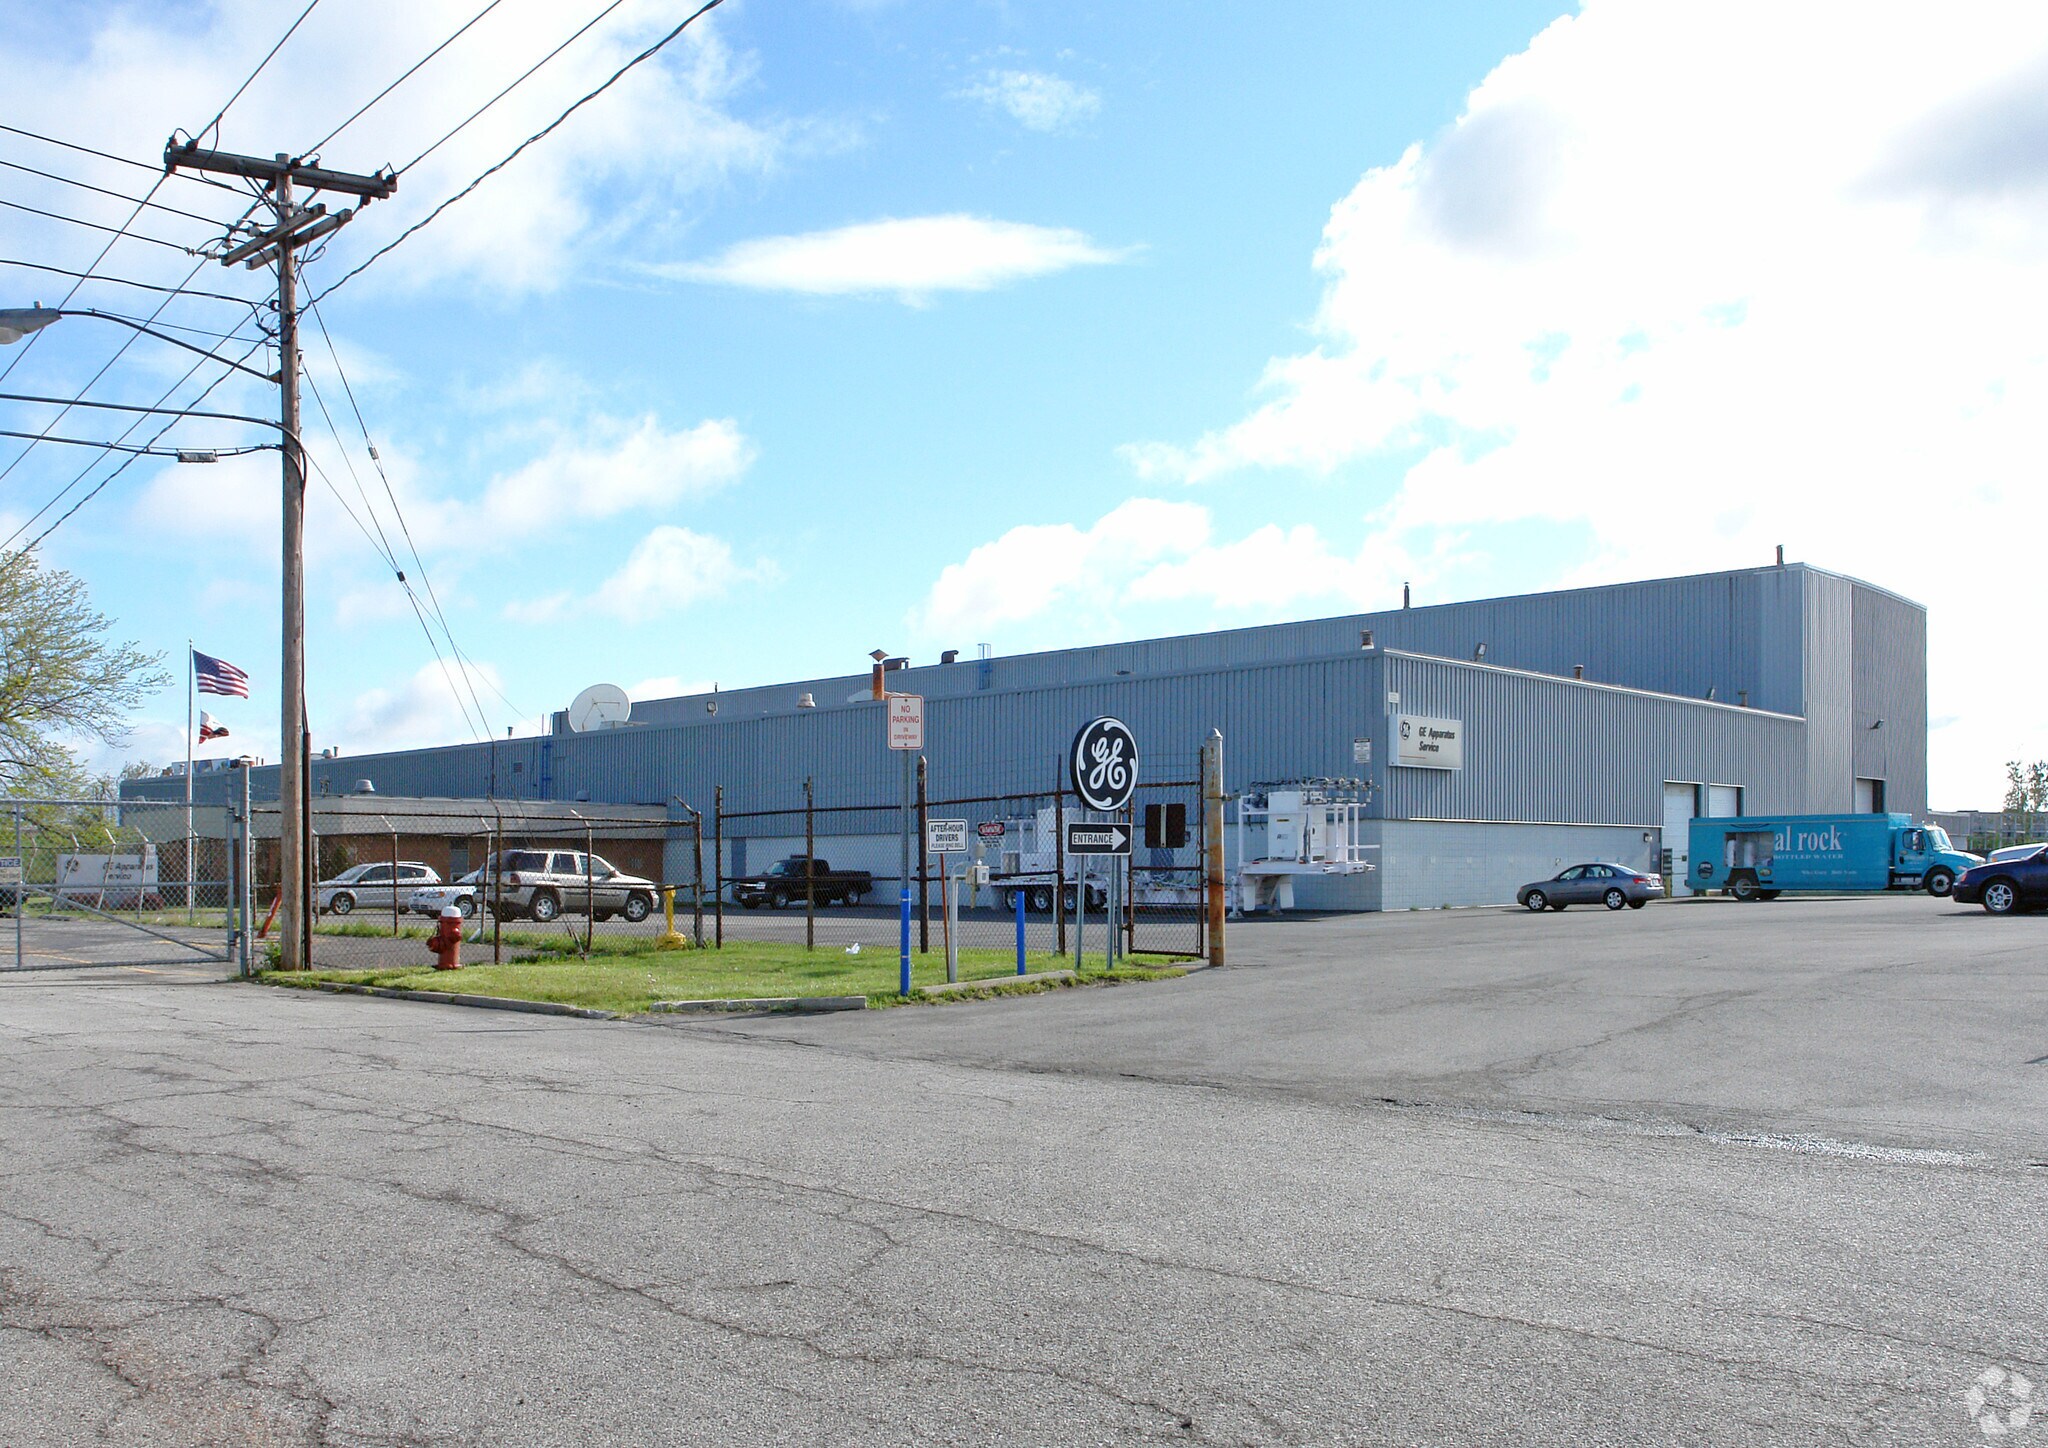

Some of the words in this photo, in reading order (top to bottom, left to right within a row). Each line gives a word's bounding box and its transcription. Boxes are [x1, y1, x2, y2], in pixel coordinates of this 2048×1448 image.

[901, 705, 910, 713] NO
[1419, 727, 1427, 737] GE
[1428, 728, 1455, 740] Apparatus
[1419, 741, 1439, 752] Service
[1089, 737, 1126, 789] GE
[936, 833, 958, 841] DRIVERS
[1073, 833, 1113, 844] ENTRANCE
[1798, 825, 1843, 851] rock
